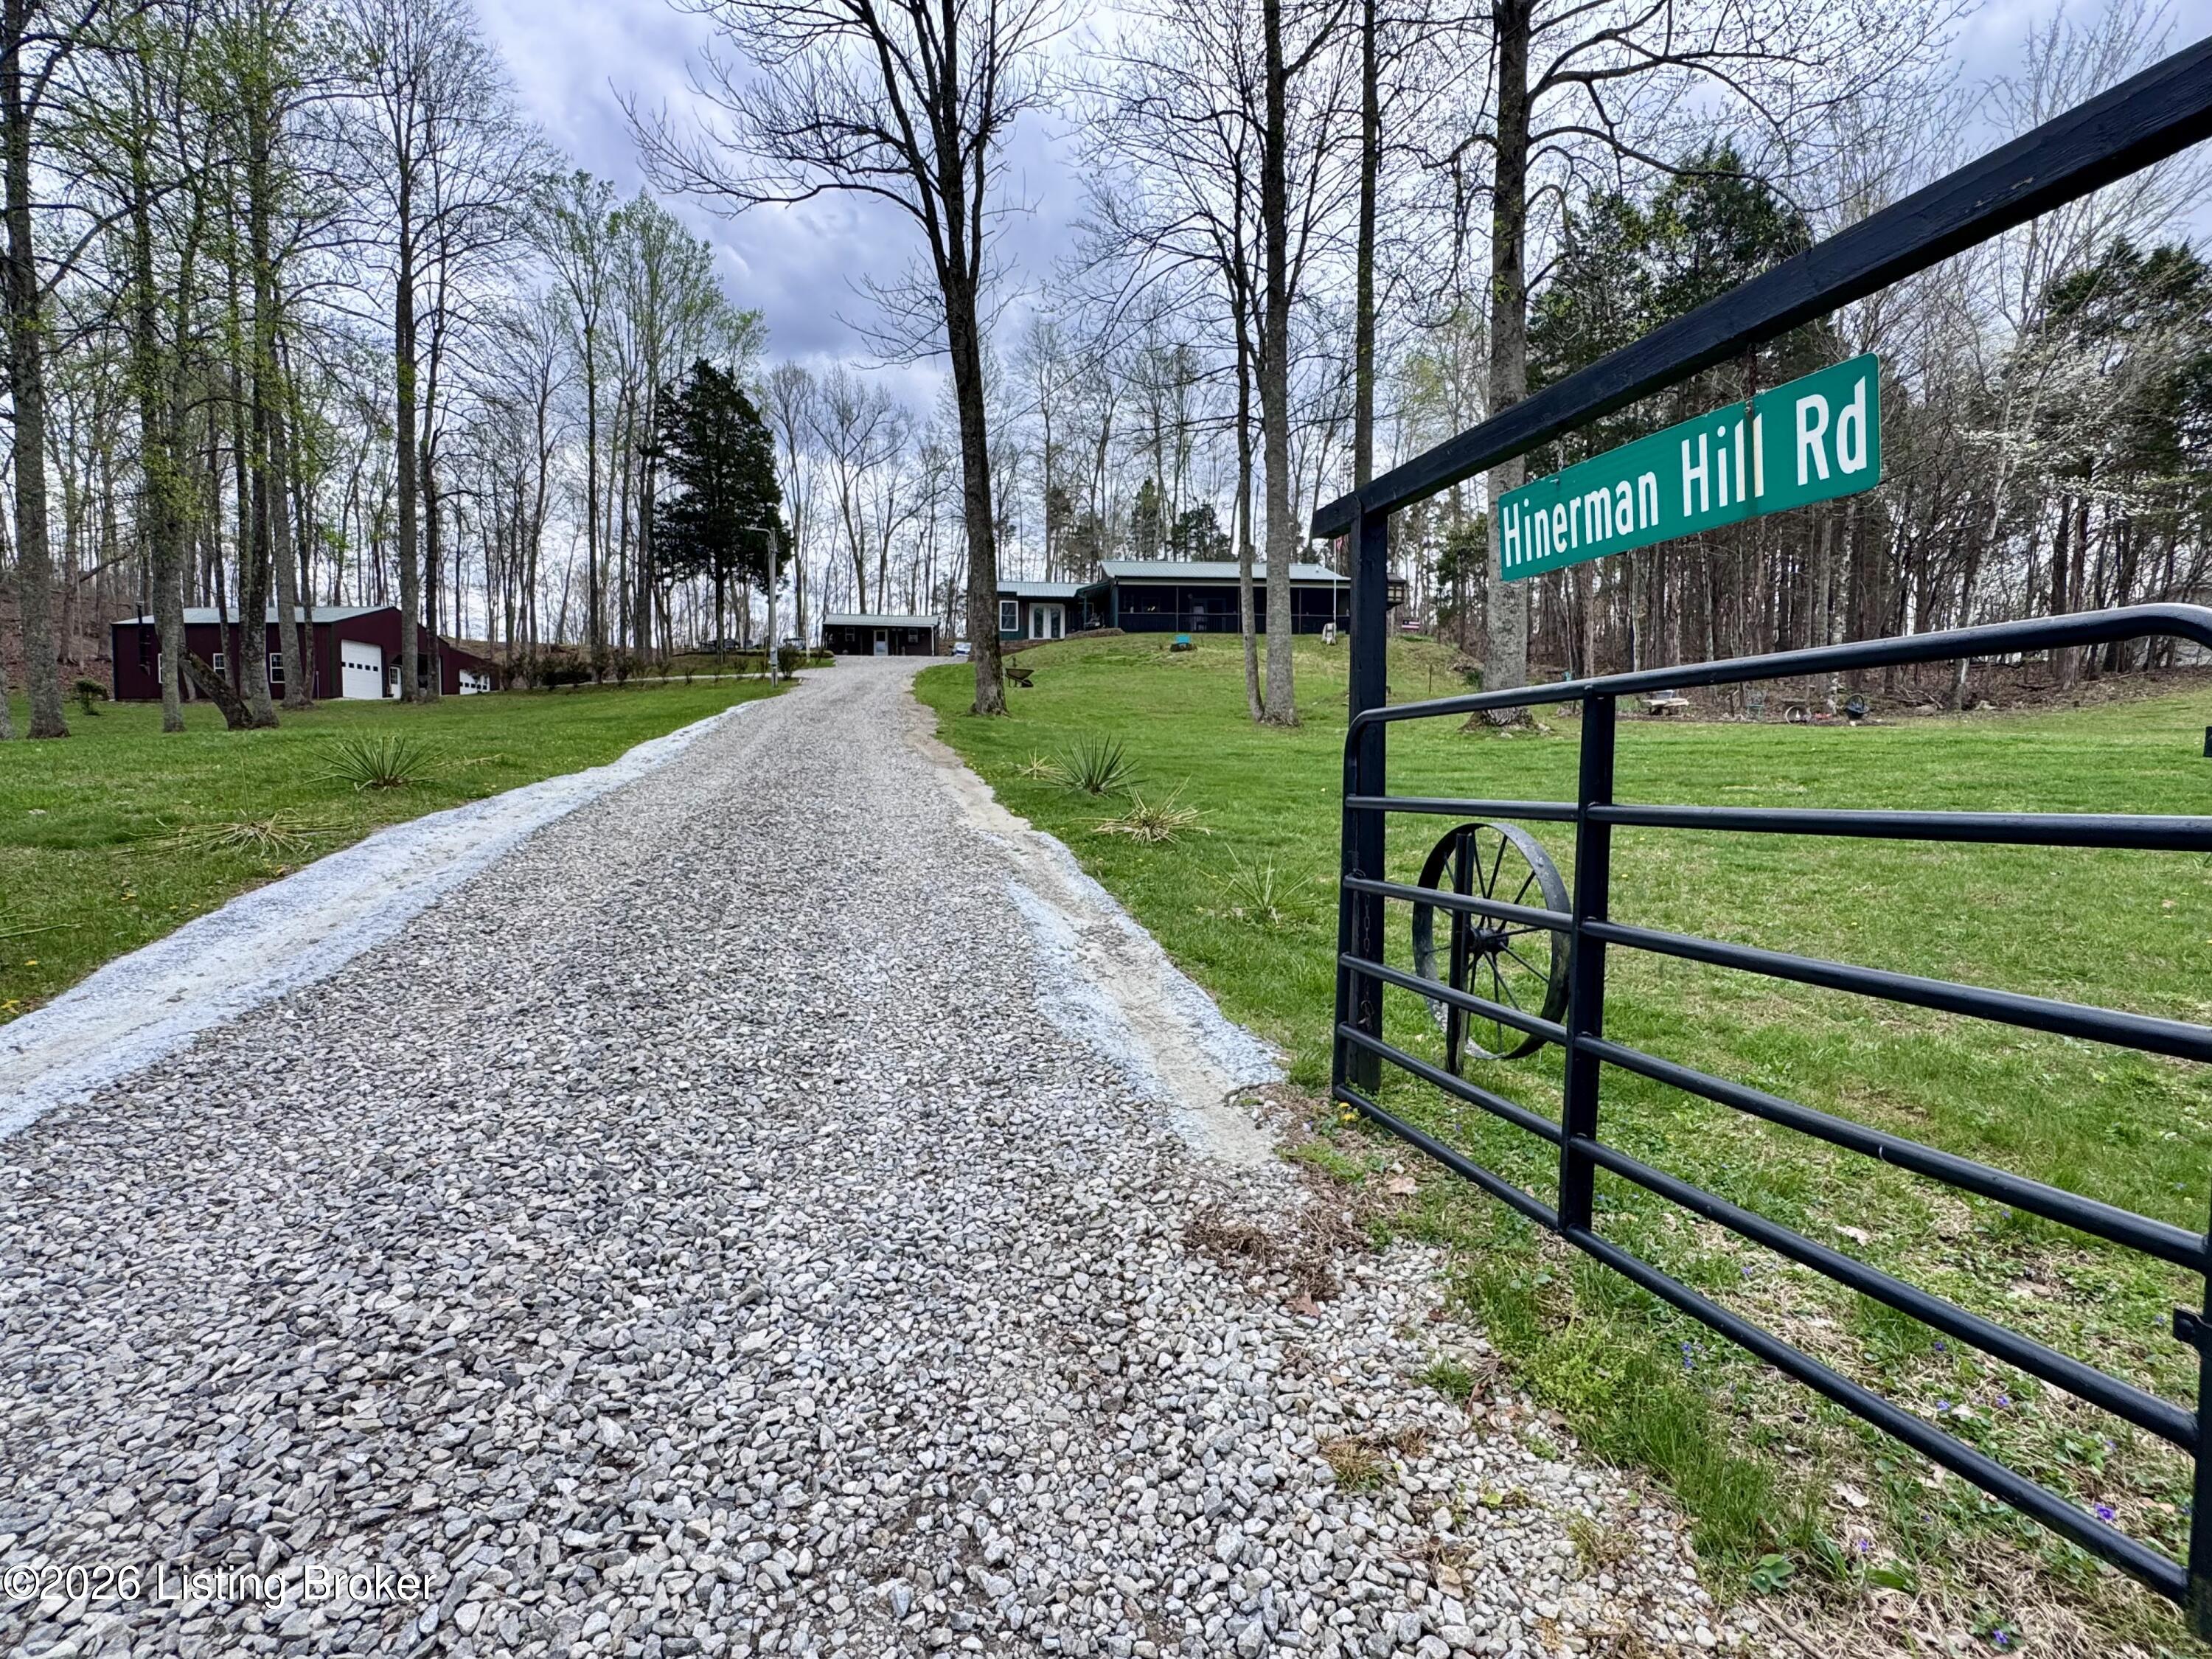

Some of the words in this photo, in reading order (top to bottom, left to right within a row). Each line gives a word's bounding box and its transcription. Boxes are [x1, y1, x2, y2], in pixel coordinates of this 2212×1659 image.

[1503, 470, 1659, 568] Hinerman
[1681, 411, 1764, 518] Hill
[1795, 375, 1868, 487] Rd
